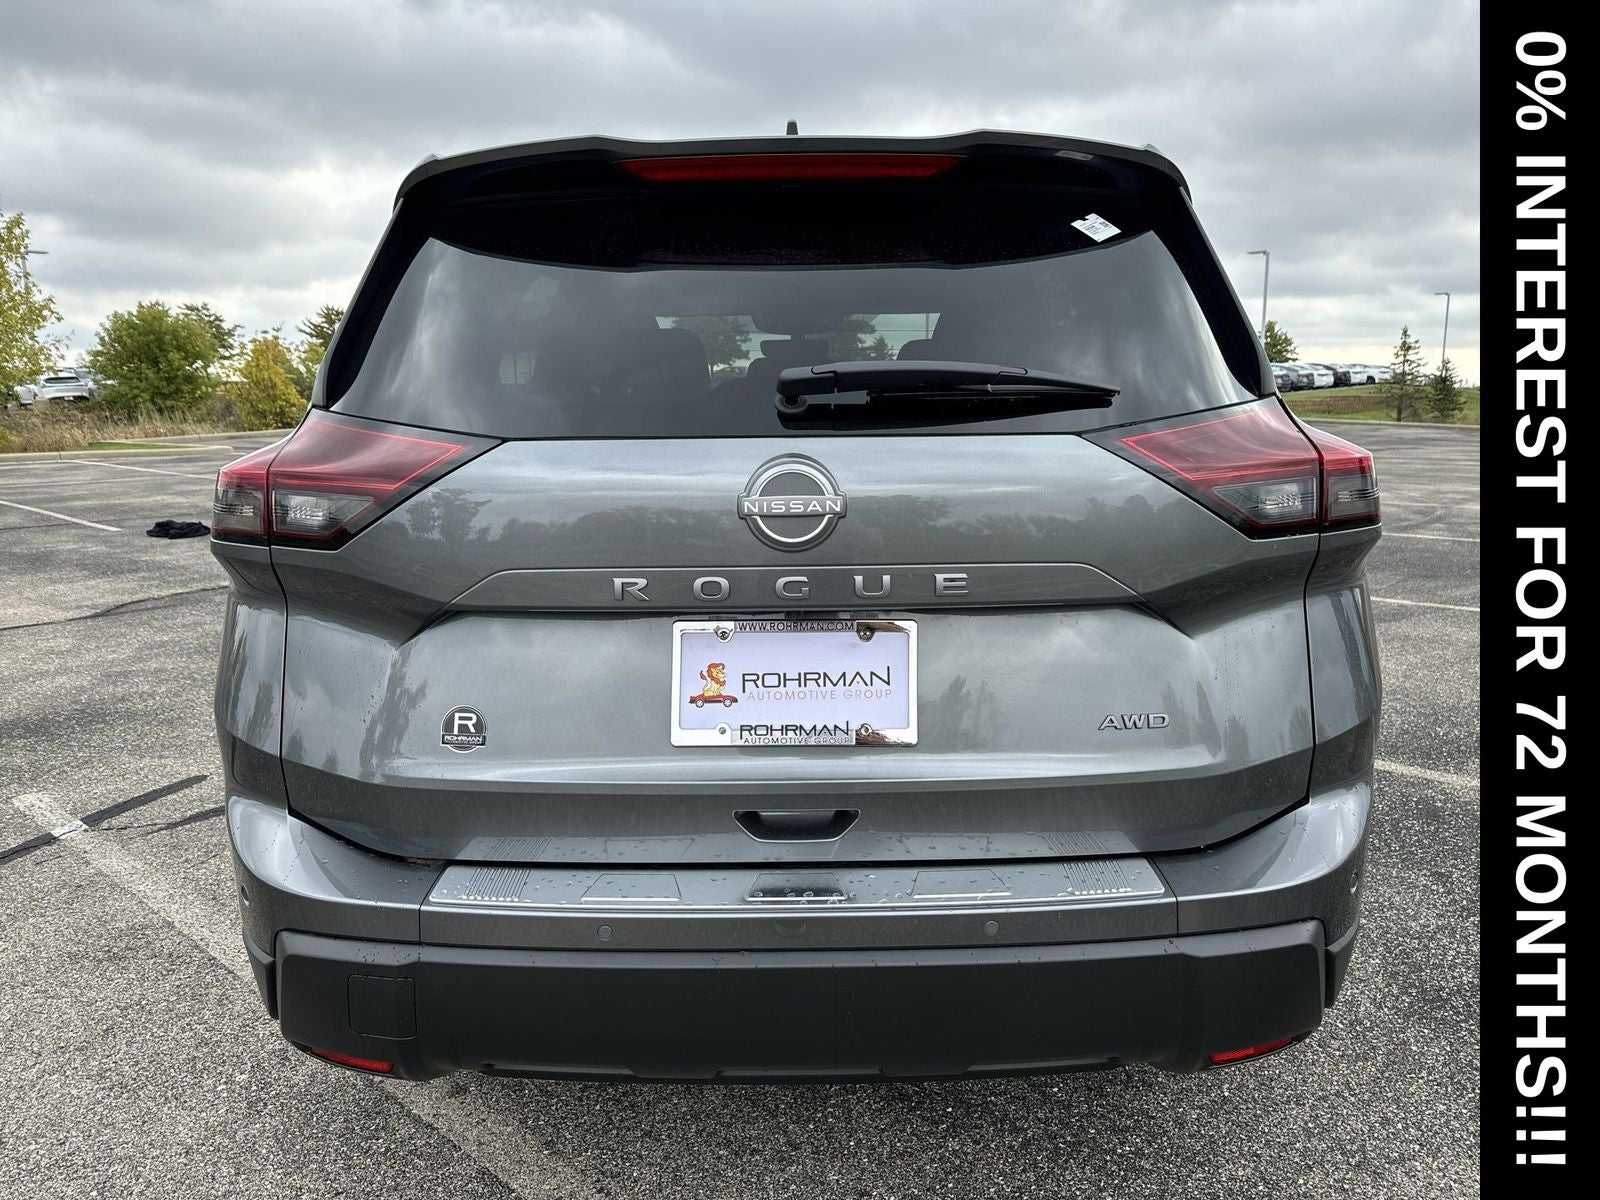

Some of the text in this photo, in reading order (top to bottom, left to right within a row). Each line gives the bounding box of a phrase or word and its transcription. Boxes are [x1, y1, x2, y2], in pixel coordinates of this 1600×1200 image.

[743, 499, 842, 513] NISSAN
[612, 572, 970, 601] ROGUE
[738, 621, 854, 632] WWW.ROHRMAN.COM
[741, 665, 891, 693] ROHRMAN
[747, 689, 892, 701] AUTOMOTIVE GROUP
[453, 712, 477, 735] R
[740, 720, 849, 740] ROHRMAN
[1098, 713, 1170, 730] AWD
